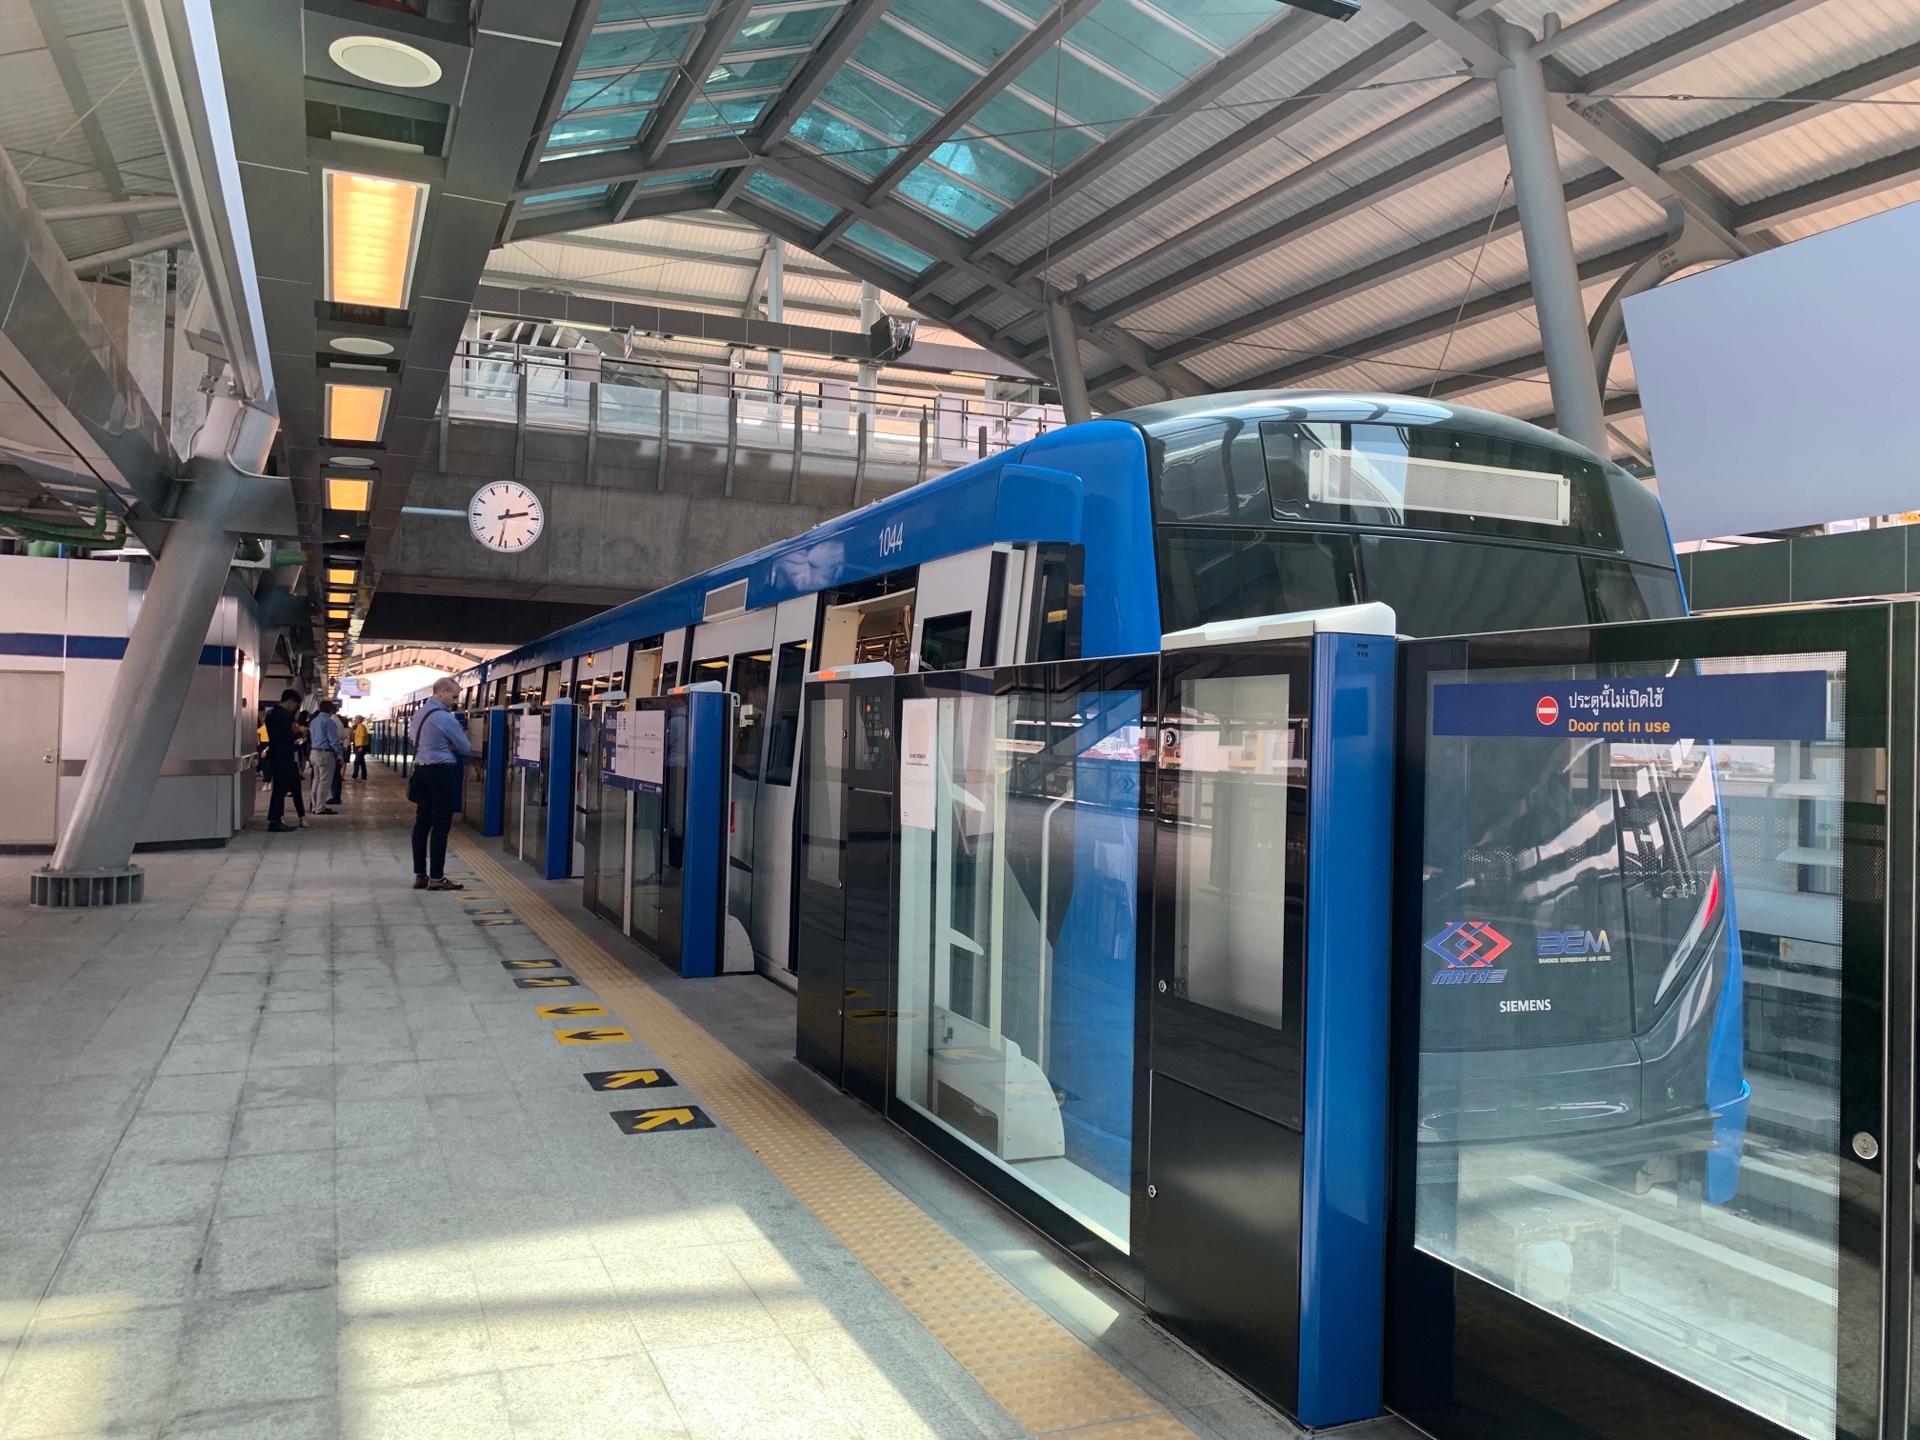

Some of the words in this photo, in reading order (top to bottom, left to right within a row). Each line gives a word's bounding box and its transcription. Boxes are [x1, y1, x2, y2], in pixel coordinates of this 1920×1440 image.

[879, 521, 904, 557] 1044
[1568, 684, 1664, 715] ประตูนี้ไม่เปิดใช้
[1568, 718, 1599, 732] Door
[1603, 719, 1624, 732] not
[1628, 719, 1641, 732] in
[1645, 721, 1670, 732] use
[1537, 929, 1611, 955] BEM
[1500, 999, 1551, 1012] SIEMENS
